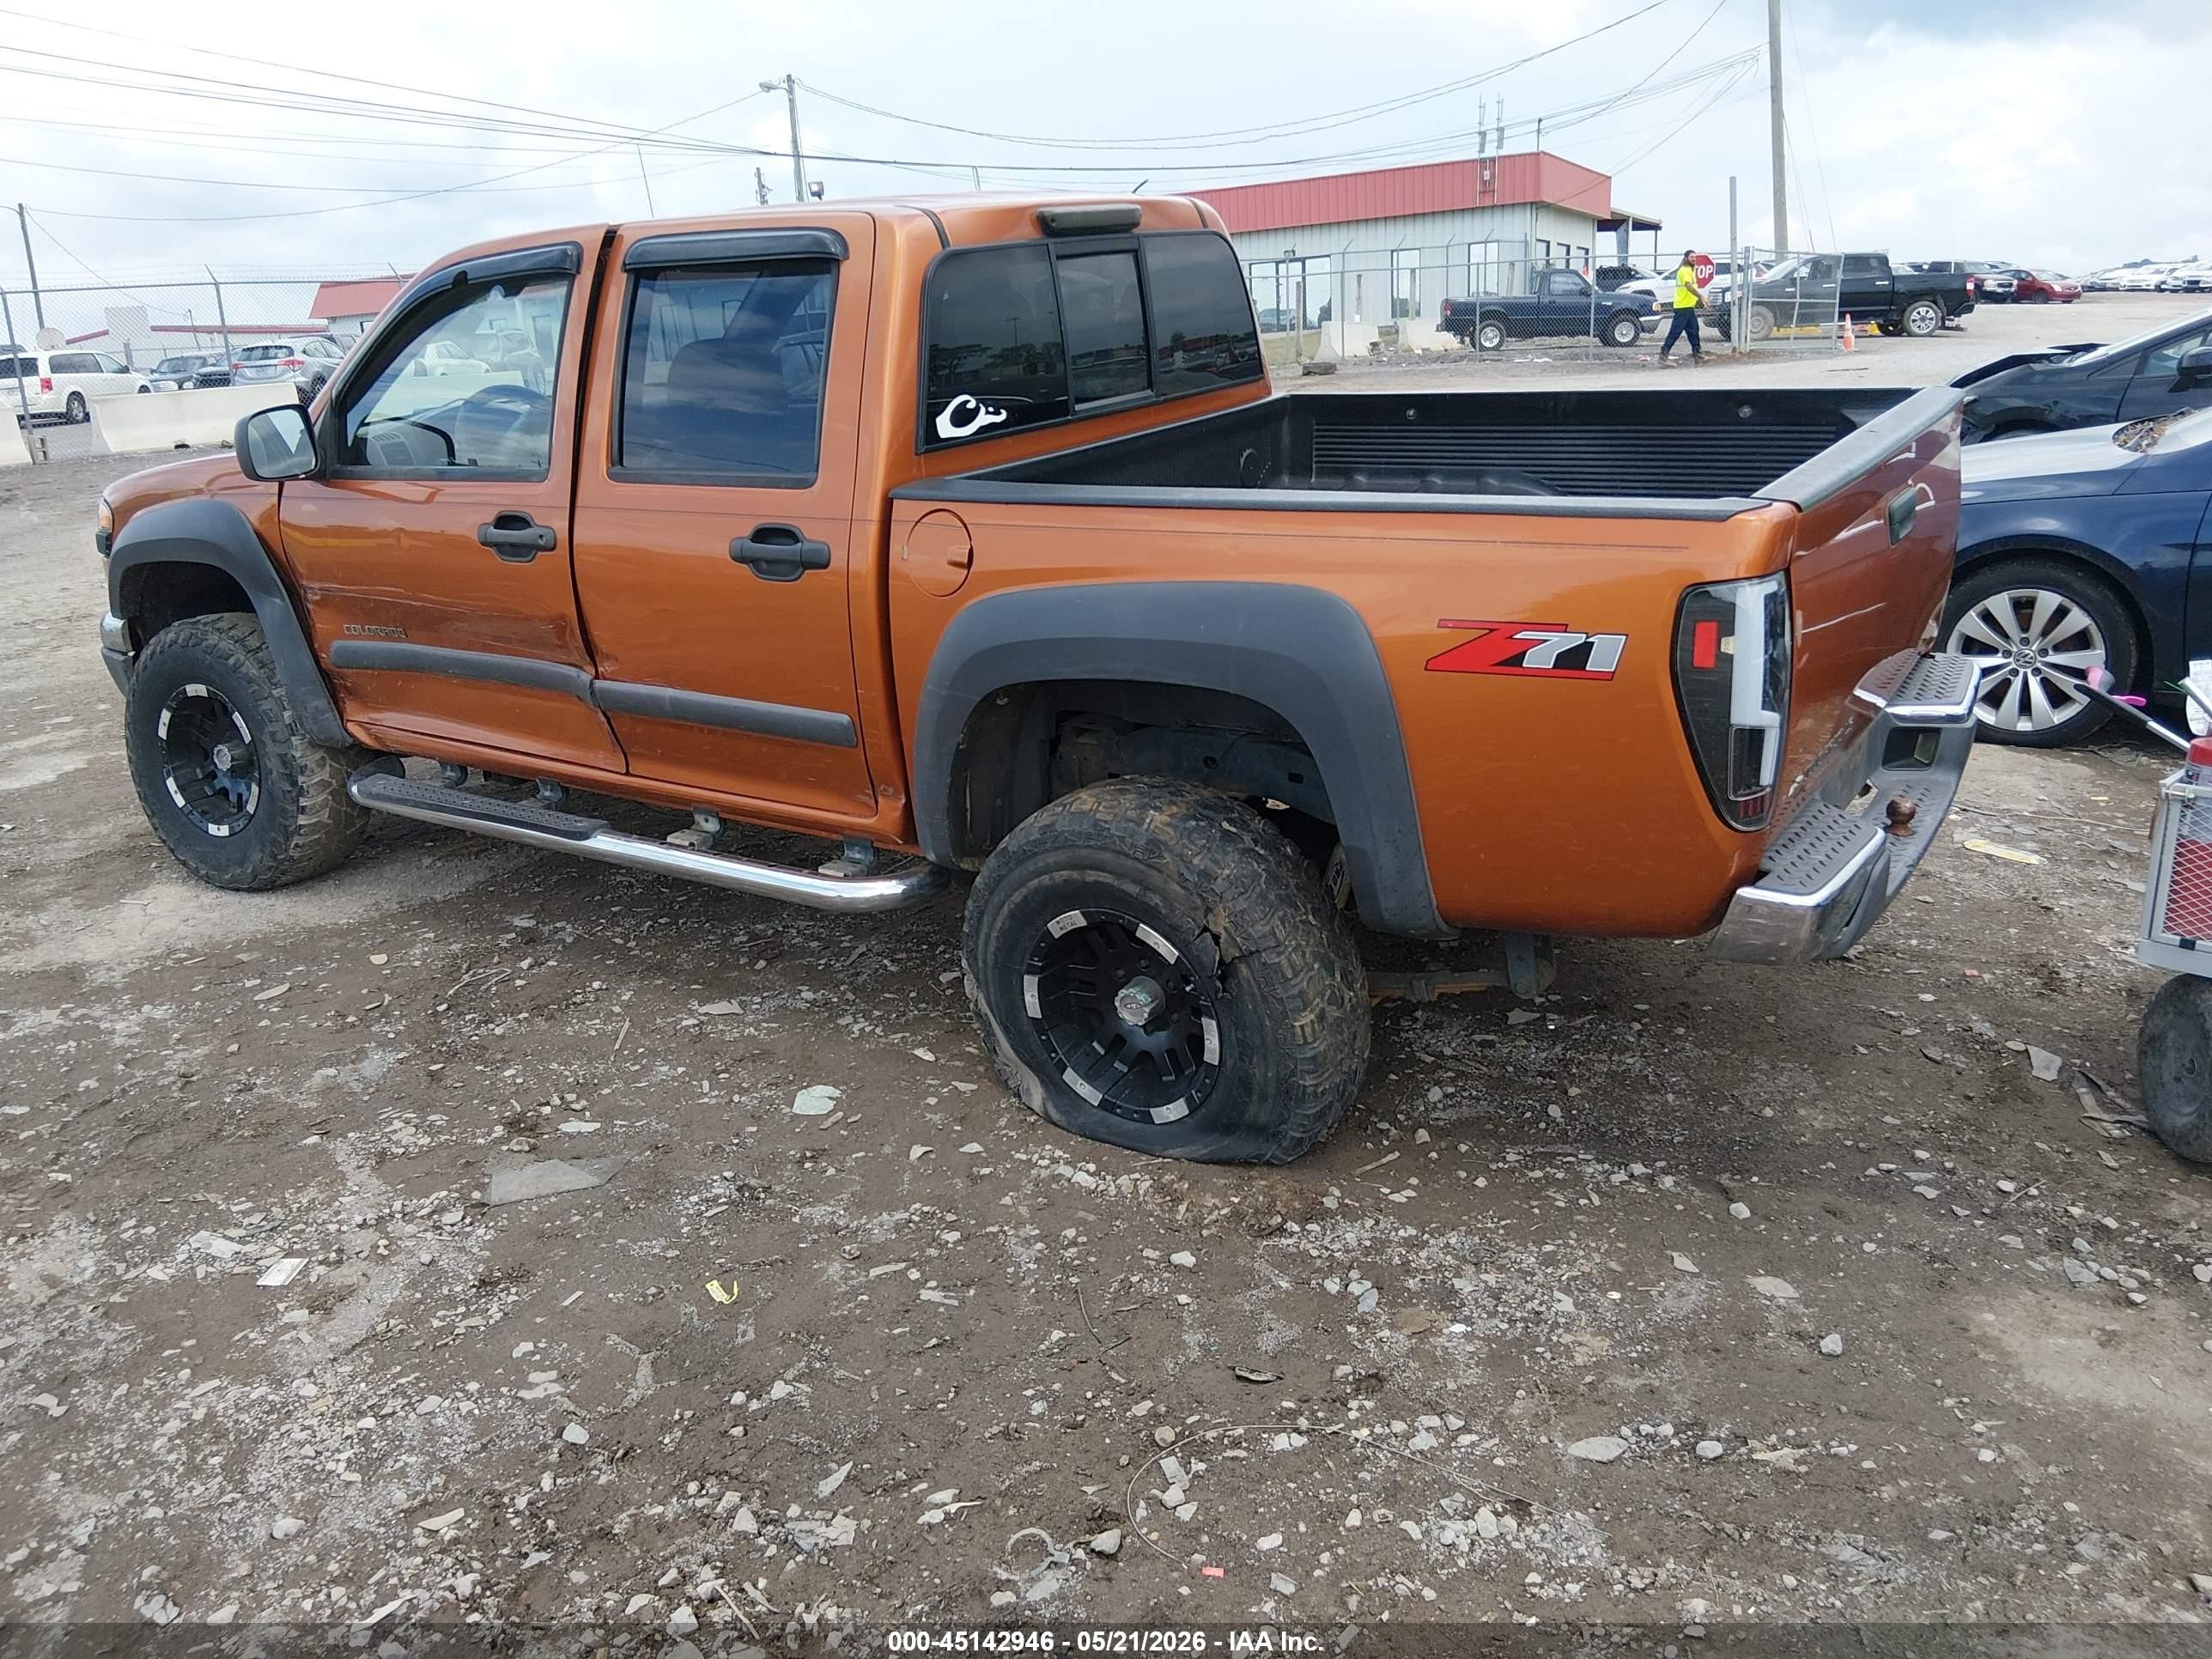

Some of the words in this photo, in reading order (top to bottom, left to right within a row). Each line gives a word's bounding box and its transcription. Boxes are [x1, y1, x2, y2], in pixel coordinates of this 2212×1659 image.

[1693, 264, 1713, 279] TOP
[343, 624, 408, 638] COLORADO
[1425, 618, 1629, 681] Z71
